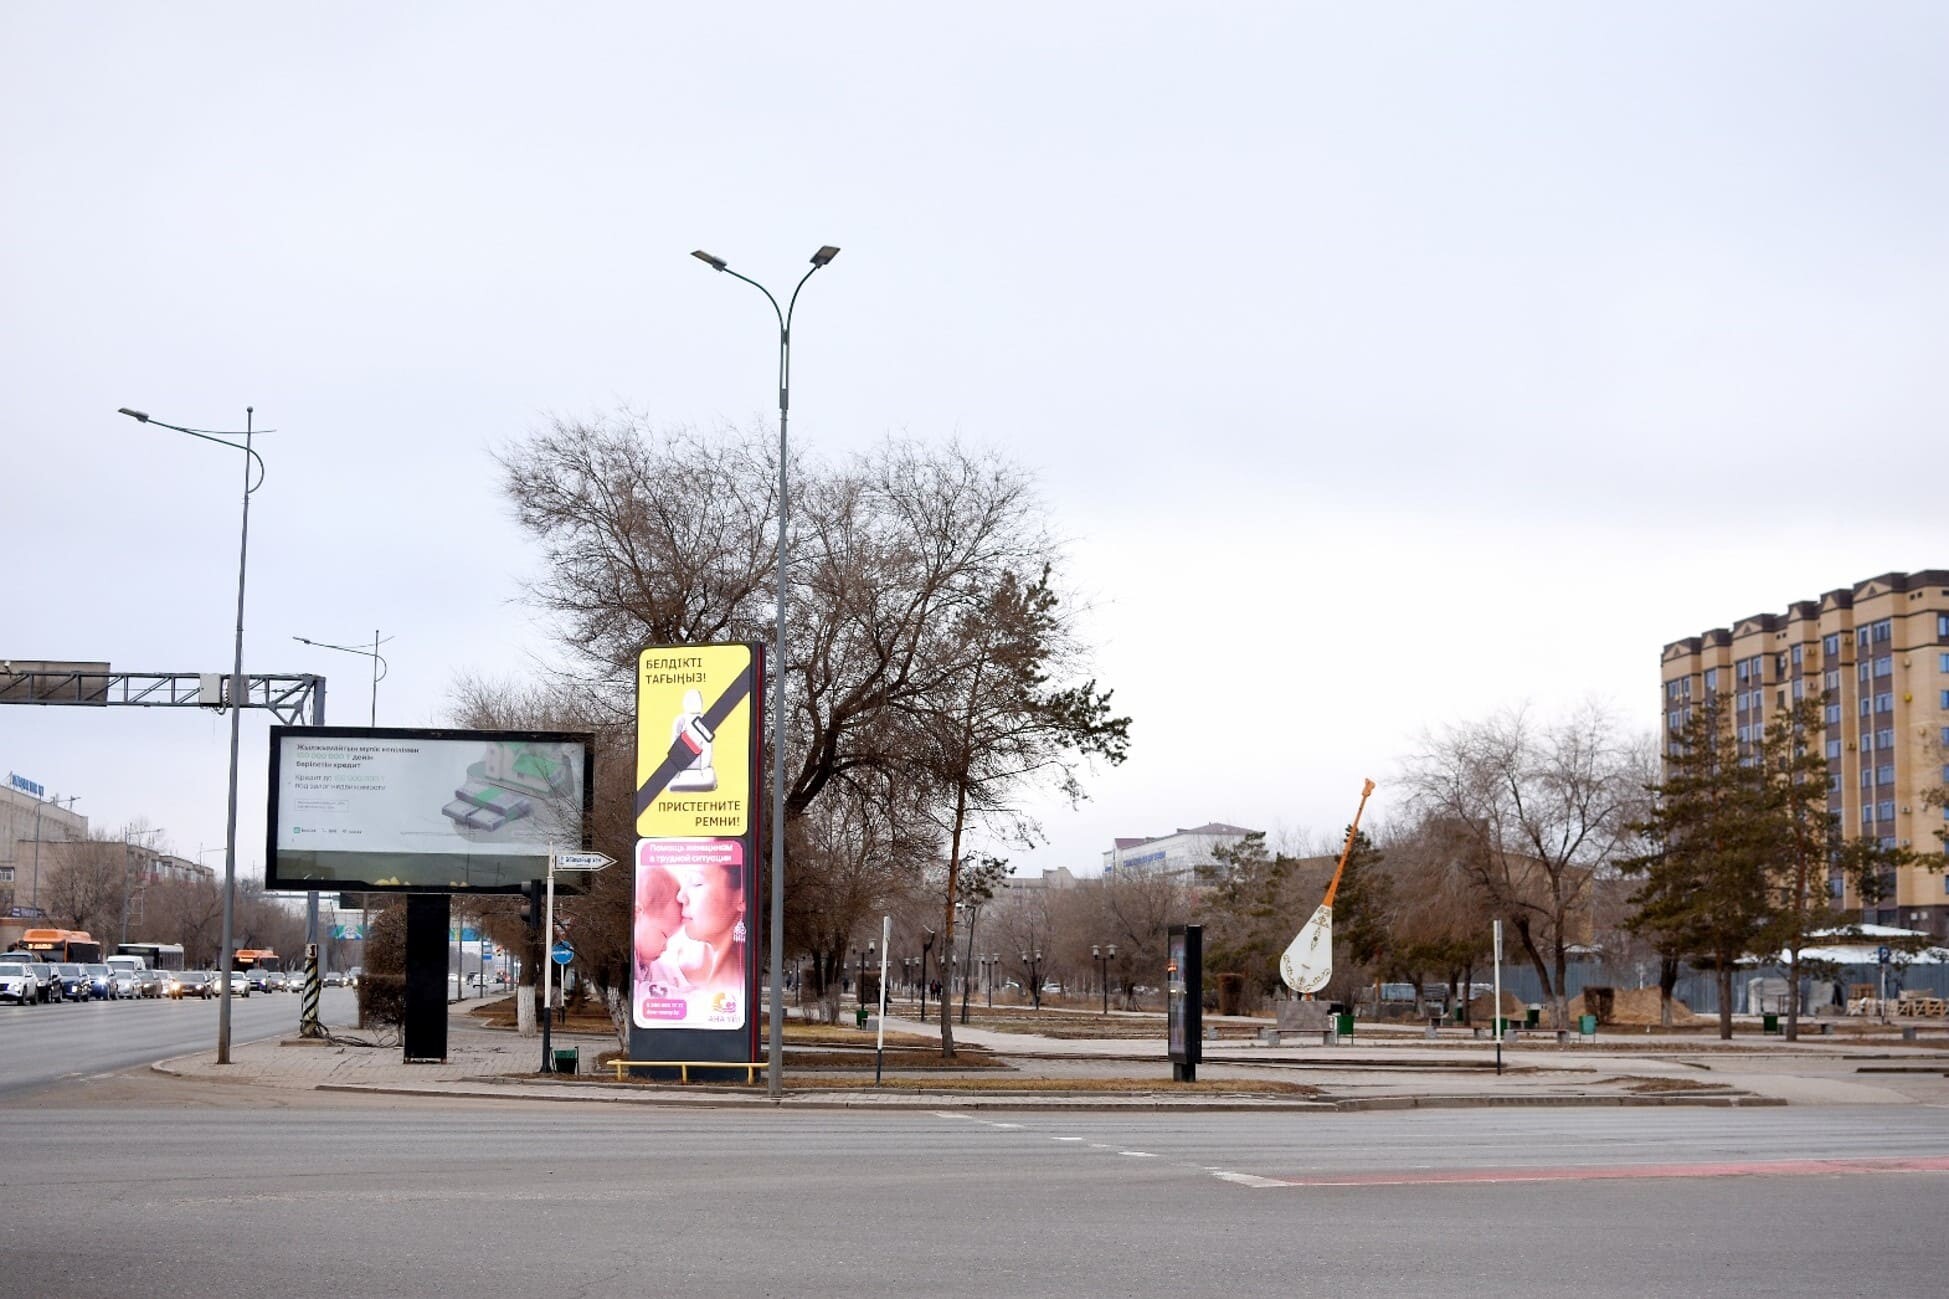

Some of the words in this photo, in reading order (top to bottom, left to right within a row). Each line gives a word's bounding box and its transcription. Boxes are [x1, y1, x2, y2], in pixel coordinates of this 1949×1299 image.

[646, 657, 702, 669] БЕЛДІКТІ
[645, 672, 706, 685] ТАҒЫҢЫЗ!
[658, 800, 741, 812] ПРИСТЕГНИТЕ
[695, 816, 740, 827] РЕМНИ!
[656, 855, 691, 864] трудной
[692, 855, 732, 863] ситуации
